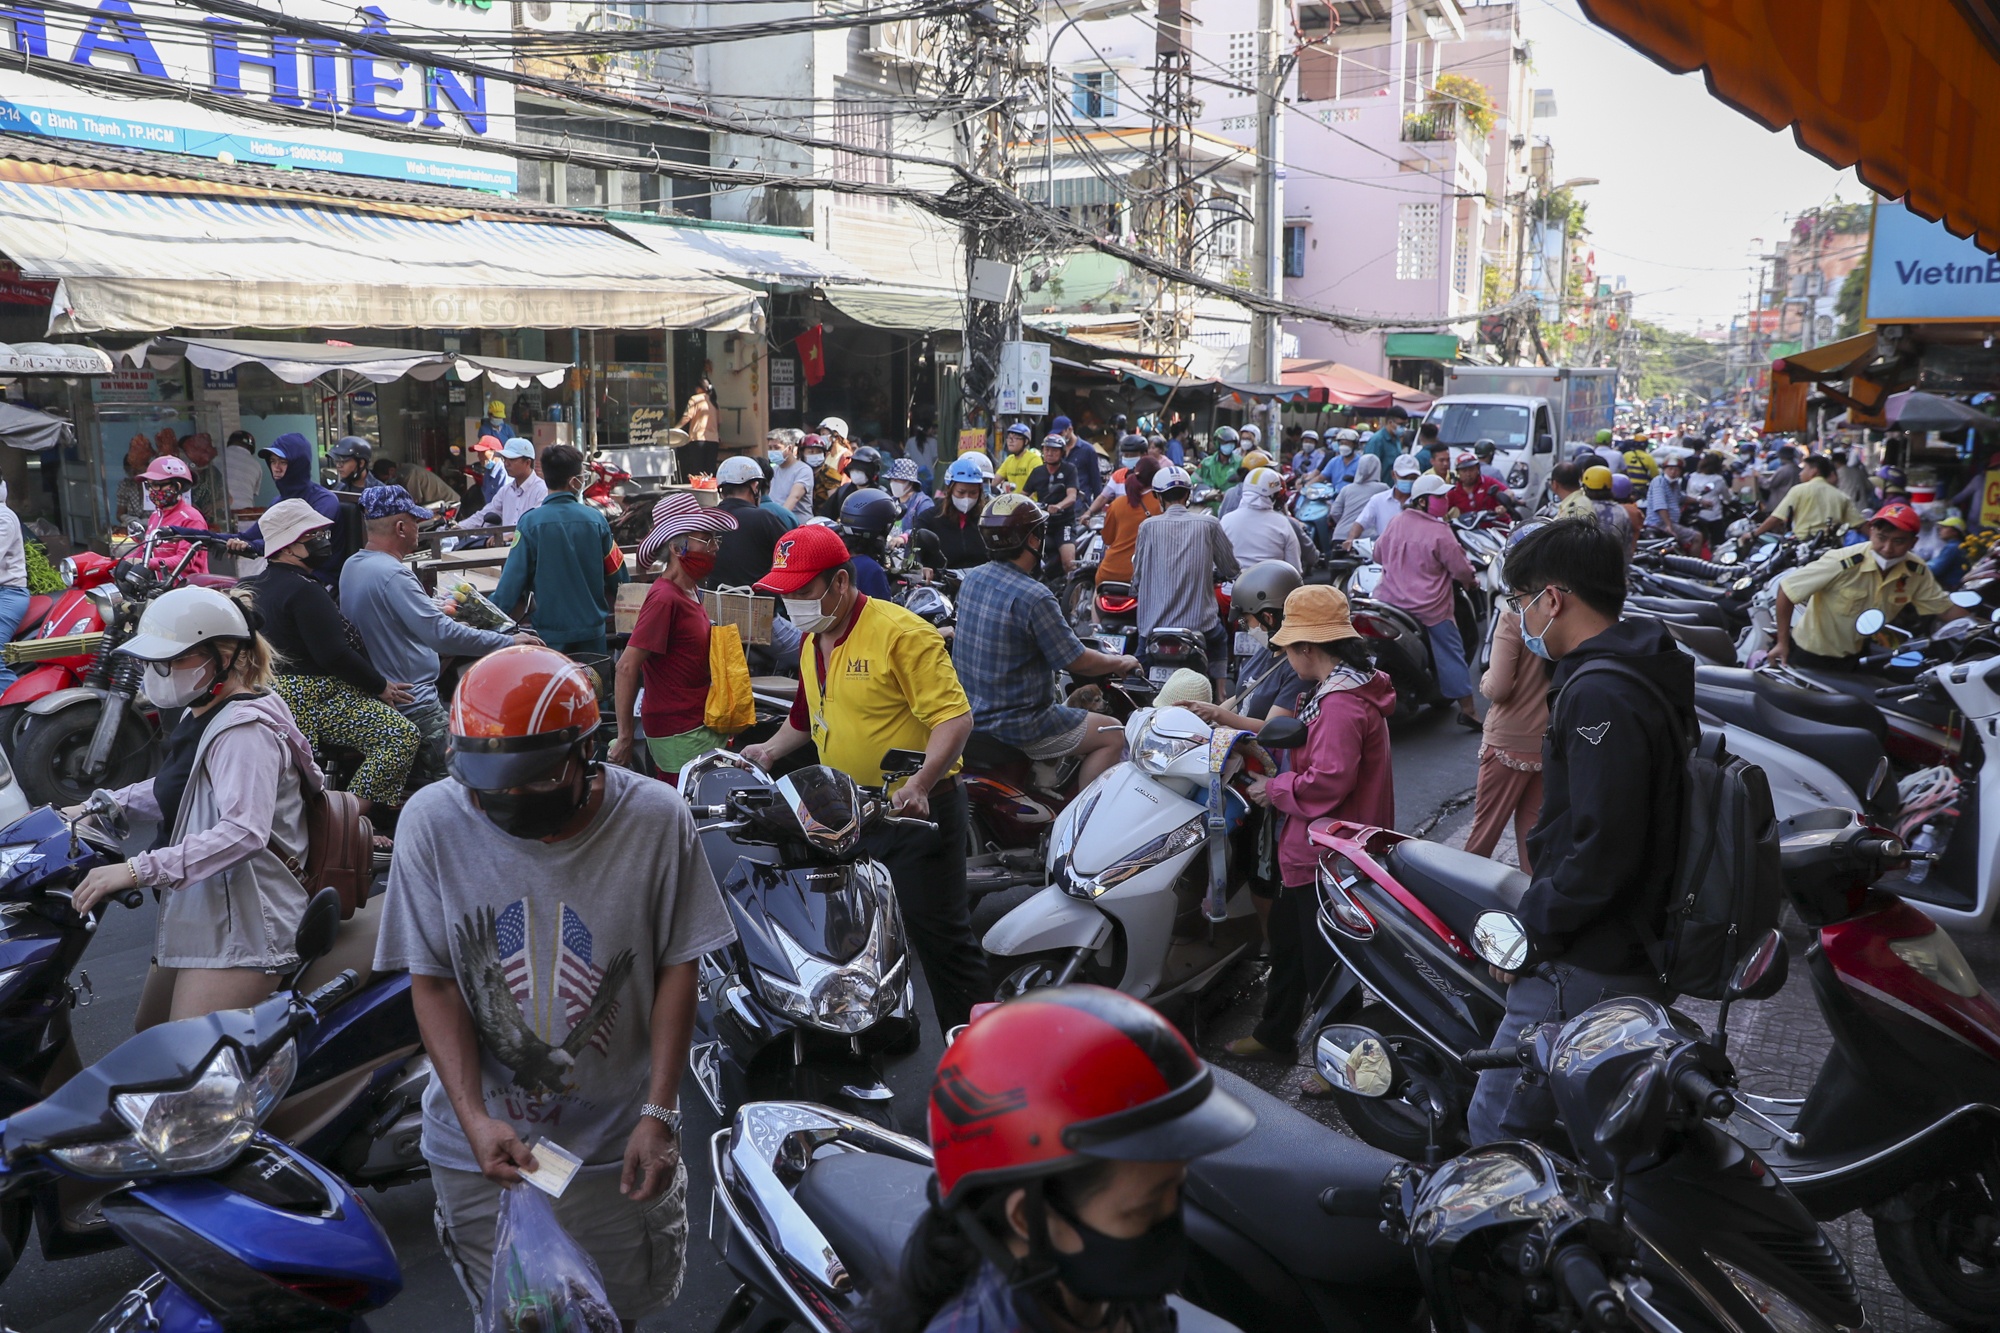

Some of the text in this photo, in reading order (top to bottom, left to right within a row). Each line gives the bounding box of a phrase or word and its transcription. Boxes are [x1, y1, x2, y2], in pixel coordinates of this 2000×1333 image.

[29, 111, 42, 126] Q
[127, 124, 175, 144] TP.HCM
[805, 872, 841, 880] HONDA
[504, 1097, 563, 1127] USA
